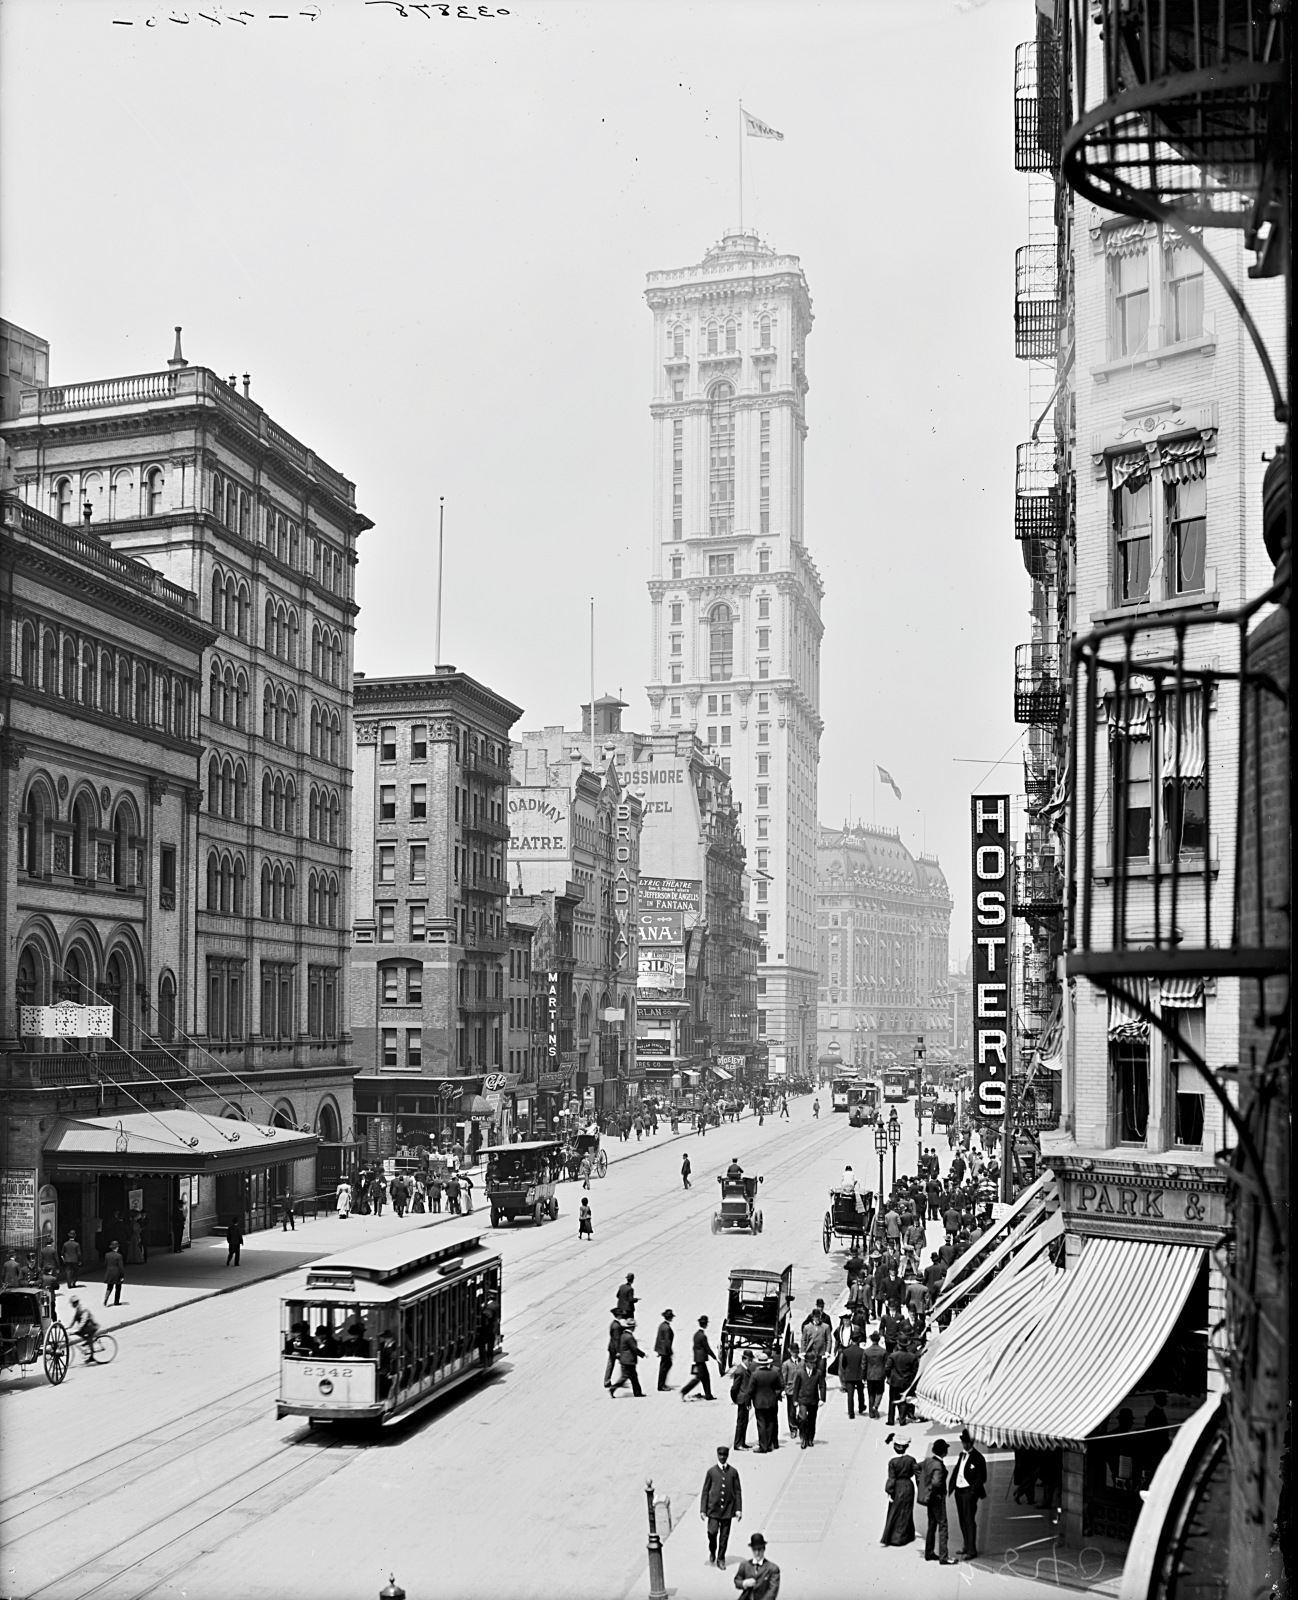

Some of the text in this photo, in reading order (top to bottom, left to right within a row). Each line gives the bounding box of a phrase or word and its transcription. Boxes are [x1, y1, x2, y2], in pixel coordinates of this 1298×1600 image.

[508, 798, 566, 824] OADWAY
[646, 801, 672, 813] TEL
[507, 836, 566, 850] EATRE.
[615, 804, 630, 967] BROADWAY
[639, 879, 693, 889] LYRIC THEATRE
[643, 891, 671, 900] JEFFERSON
[656, 900, 694, 910] FANTANA
[638, 960, 673, 975] RILBY
[636, 1008, 662, 1016] RLAN
[1076, 1183, 1206, 1221] PARK &
[303, 1366, 354, 1378] 2342
